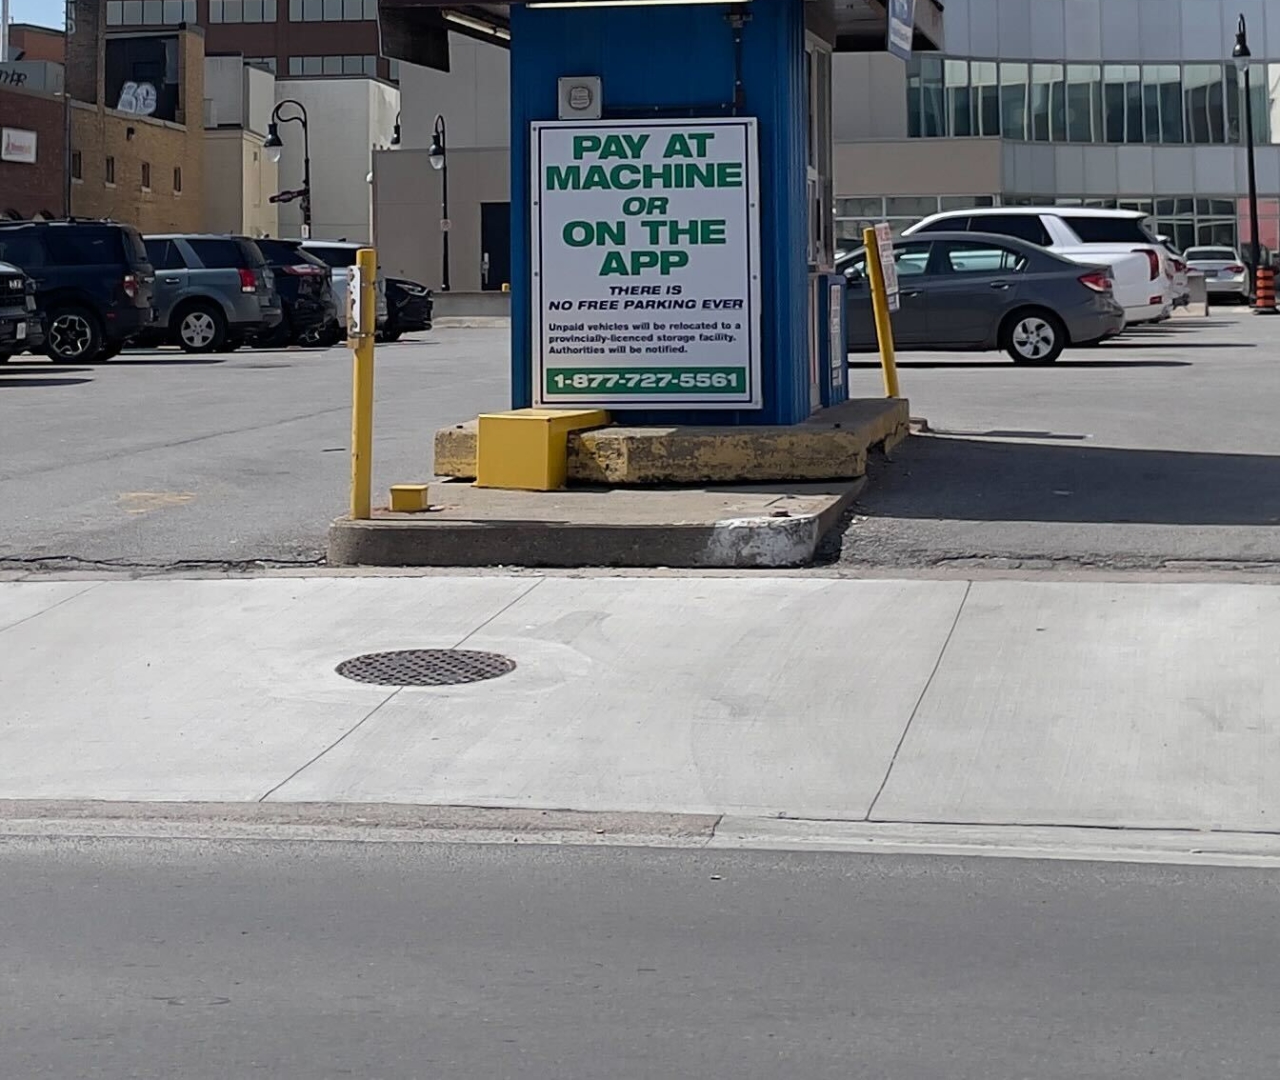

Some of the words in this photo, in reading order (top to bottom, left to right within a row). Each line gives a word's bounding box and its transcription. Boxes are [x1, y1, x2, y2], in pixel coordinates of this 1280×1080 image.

[573, 134, 650, 160] PAY
[663, 132, 715, 158] AT
[546, 162, 743, 191] MACHINE
[622, 196, 669, 216] OR
[562, 220, 626, 247] ON
[641, 219, 727, 246] THE
[598, 250, 689, 277] APP
[609, 285, 662, 296] THERE
[665, 285, 682, 295] IS
[548, 300, 573, 311] NO
[577, 300, 619, 310] FREE
[623, 299, 697, 310] PARKING
[701, 298, 744, 310] EVER
[548, 322, 584, 332] Unpaid
[587, 322, 629, 331] vehicles
[632, 322, 650, 331] will
[653, 322, 666, 331] be
[669, 321, 718, 331] relocated
[721, 322, 731, 330] to
[548, 334, 653, 344] provincially-licenced
[656, 334, 695, 343] storage
[699, 333, 736, 343] facility.
[548, 346, 605, 354] Authorities
[608, 345, 626, 354] will
[629, 345, 642, 354] be
[645, 345, 688, 354] notified.
[554, 373, 738, 388] 1-877-727-5561
